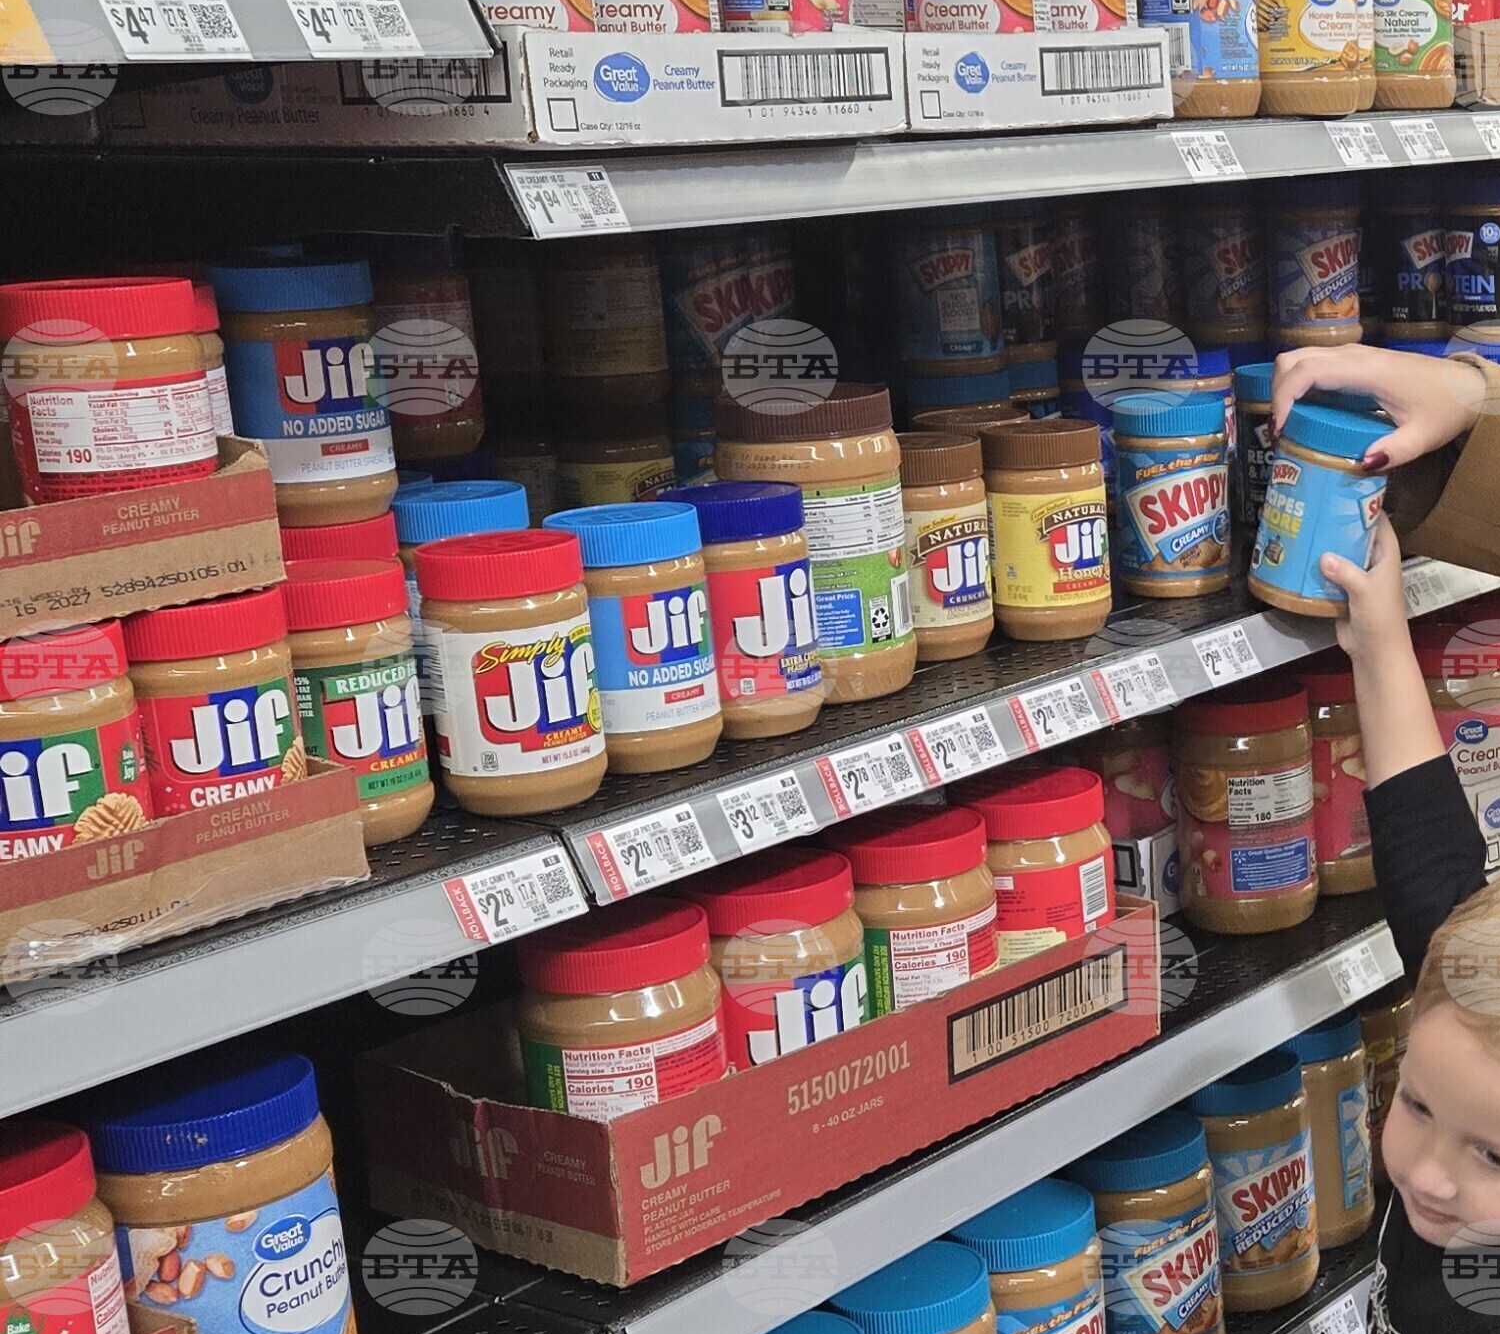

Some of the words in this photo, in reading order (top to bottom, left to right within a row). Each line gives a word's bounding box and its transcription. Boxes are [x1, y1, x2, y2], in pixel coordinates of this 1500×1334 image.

[924, 2, 987, 20] Creamy
[1384, 17, 1419, 28] Natural
[630, 21, 667, 33] Butter
[925, 19, 955, 32] Peanut
[957, 18, 989, 31] Butter
[549, 47, 573, 58] Retail
[549, 62, 575, 76] Ready
[599, 65, 638, 83] Great
[664, 65, 700, 79] Creamy
[917, 72, 949, 84] Packaging
[1001, 61, 1027, 72] Creamy
[543, 77, 588, 91] Packaging
[653, 79, 684, 92] Peanut
[686, 78, 715, 91] Butter
[284, 344, 374, 403] Jif
[29, 395, 73, 406] Nutrition
[31, 407, 57, 417] Facts
[282, 419, 304, 436] NO
[307, 415, 341, 435] ADDED
[344, 410, 385, 430] SUGAR
[66, 449, 92, 464] 190
[329, 441, 363, 453] CREAMY
[117, 497, 180, 520] CREAMY
[1140, 472, 1227, 536] SKIPPY
[102, 517, 150, 535] PEANUT
[153, 509, 199, 525] BUTTER
[1171, 522, 1209, 552] CREAMY
[630, 589, 705, 655] Jif
[476, 631, 566, 673] Simply
[484, 643, 595, 732] Jif
[628, 671, 648, 687] NO
[652, 664, 692, 684] ADDED
[670, 689, 700, 701] CREAMY
[331, 675, 419, 759] Jif
[170, 689, 290, 774] Jif
[190, 773, 276, 808] CREAMY
[1228, 777, 1266, 790] Nutrition
[210, 799, 271, 826] CREAMY
[196, 819, 243, 844] PEANUT
[245, 808, 290, 834] BUTTER
[86, 840, 145, 880] Jif
[595, 840, 622, 892] ROLLBACK
[453, 887, 482, 940] ROLLBACK
[892, 927, 937, 941] Nutrition
[939, 922, 965, 935] Facts
[894, 958, 936, 970] Calories
[945, 949, 966, 963] 190
[1012, 1021, 1050, 1046] 51500
[1058, 1000, 1095, 1023] 72001
[564, 1048, 615, 1061] Nutrition
[618, 1045, 651, 1057] Facts
[568, 1081, 614, 1095] Calories
[626, 1075, 654, 1090] 190
[787, 1040, 911, 1116] 5150072001
[640, 1113, 723, 1189] Jif
[642, 1183, 688, 1210] CREAMY
[1231, 1153, 1308, 1222] SKIPPY
[643, 1199, 687, 1225] PEANUT
[689, 1180, 730, 1205] BUTTER
[260, 1222, 304, 1248] Great
[644, 1227, 676, 1245] HANDLE
[700, 1206, 721, 1221] CARE
[259, 1233, 345, 1297] Crunchy
[266, 1283, 323, 1318] Peanut
[6, 1321, 30, 1334] Bake
